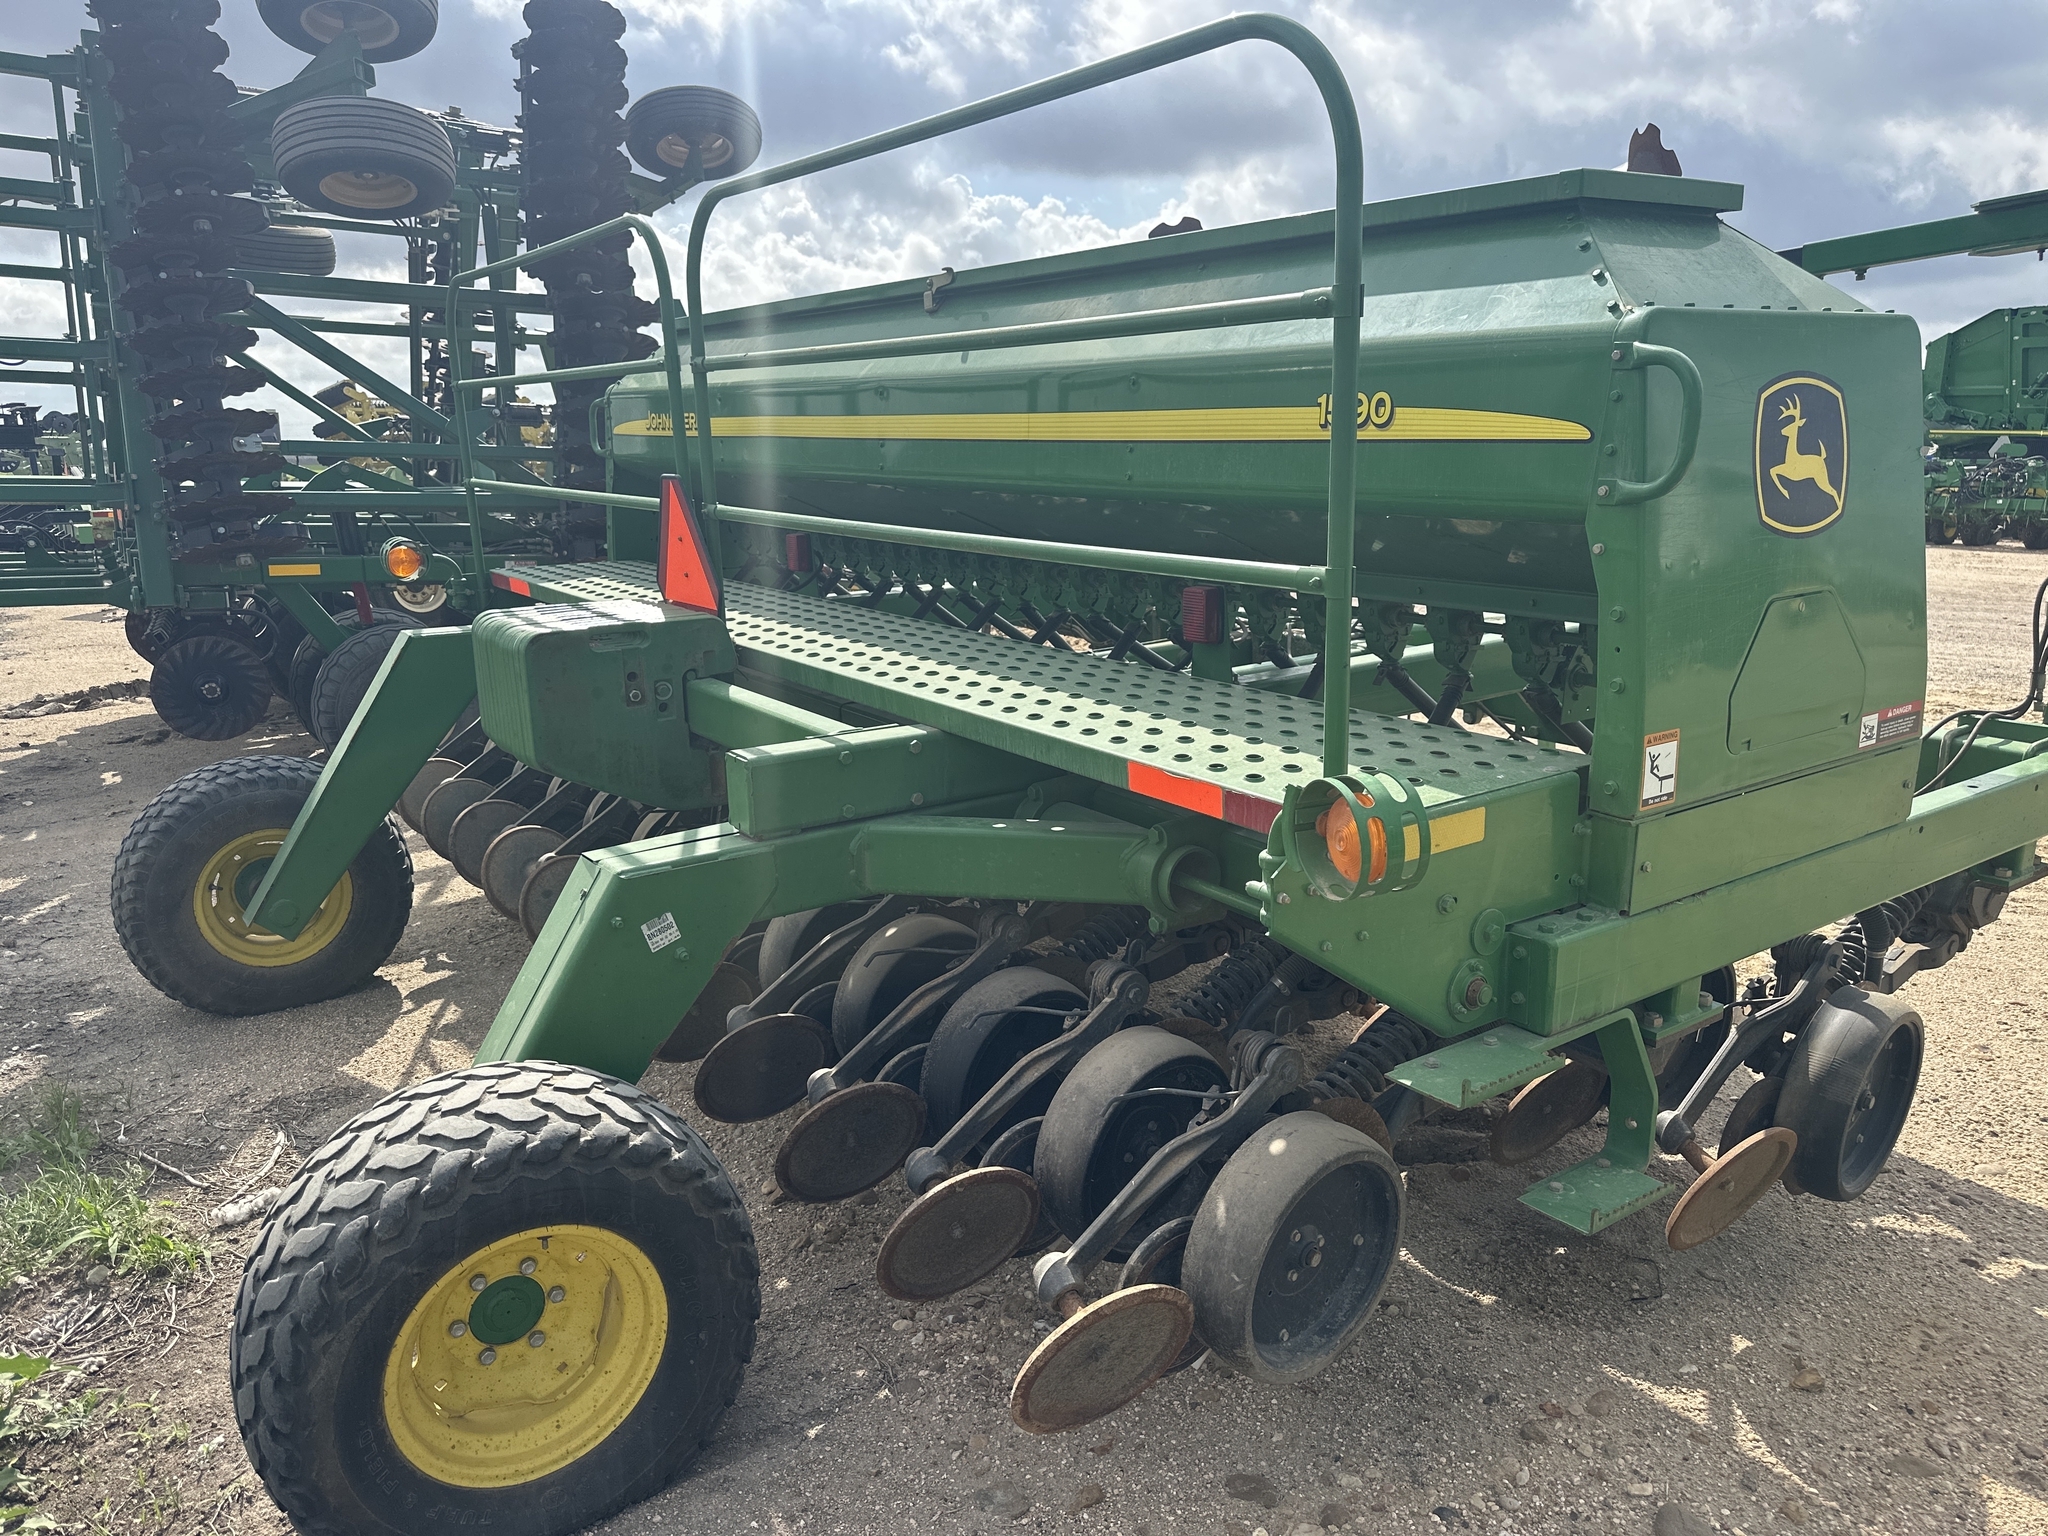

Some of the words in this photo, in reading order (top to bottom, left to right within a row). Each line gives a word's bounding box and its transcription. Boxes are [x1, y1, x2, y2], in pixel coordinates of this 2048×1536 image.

[1892, 704, 1913, 716] DANGER
[1652, 731, 1678, 743] WARNING
[359, 1428, 400, 1495] FIELD
[426, 1503, 493, 1525] TURF
